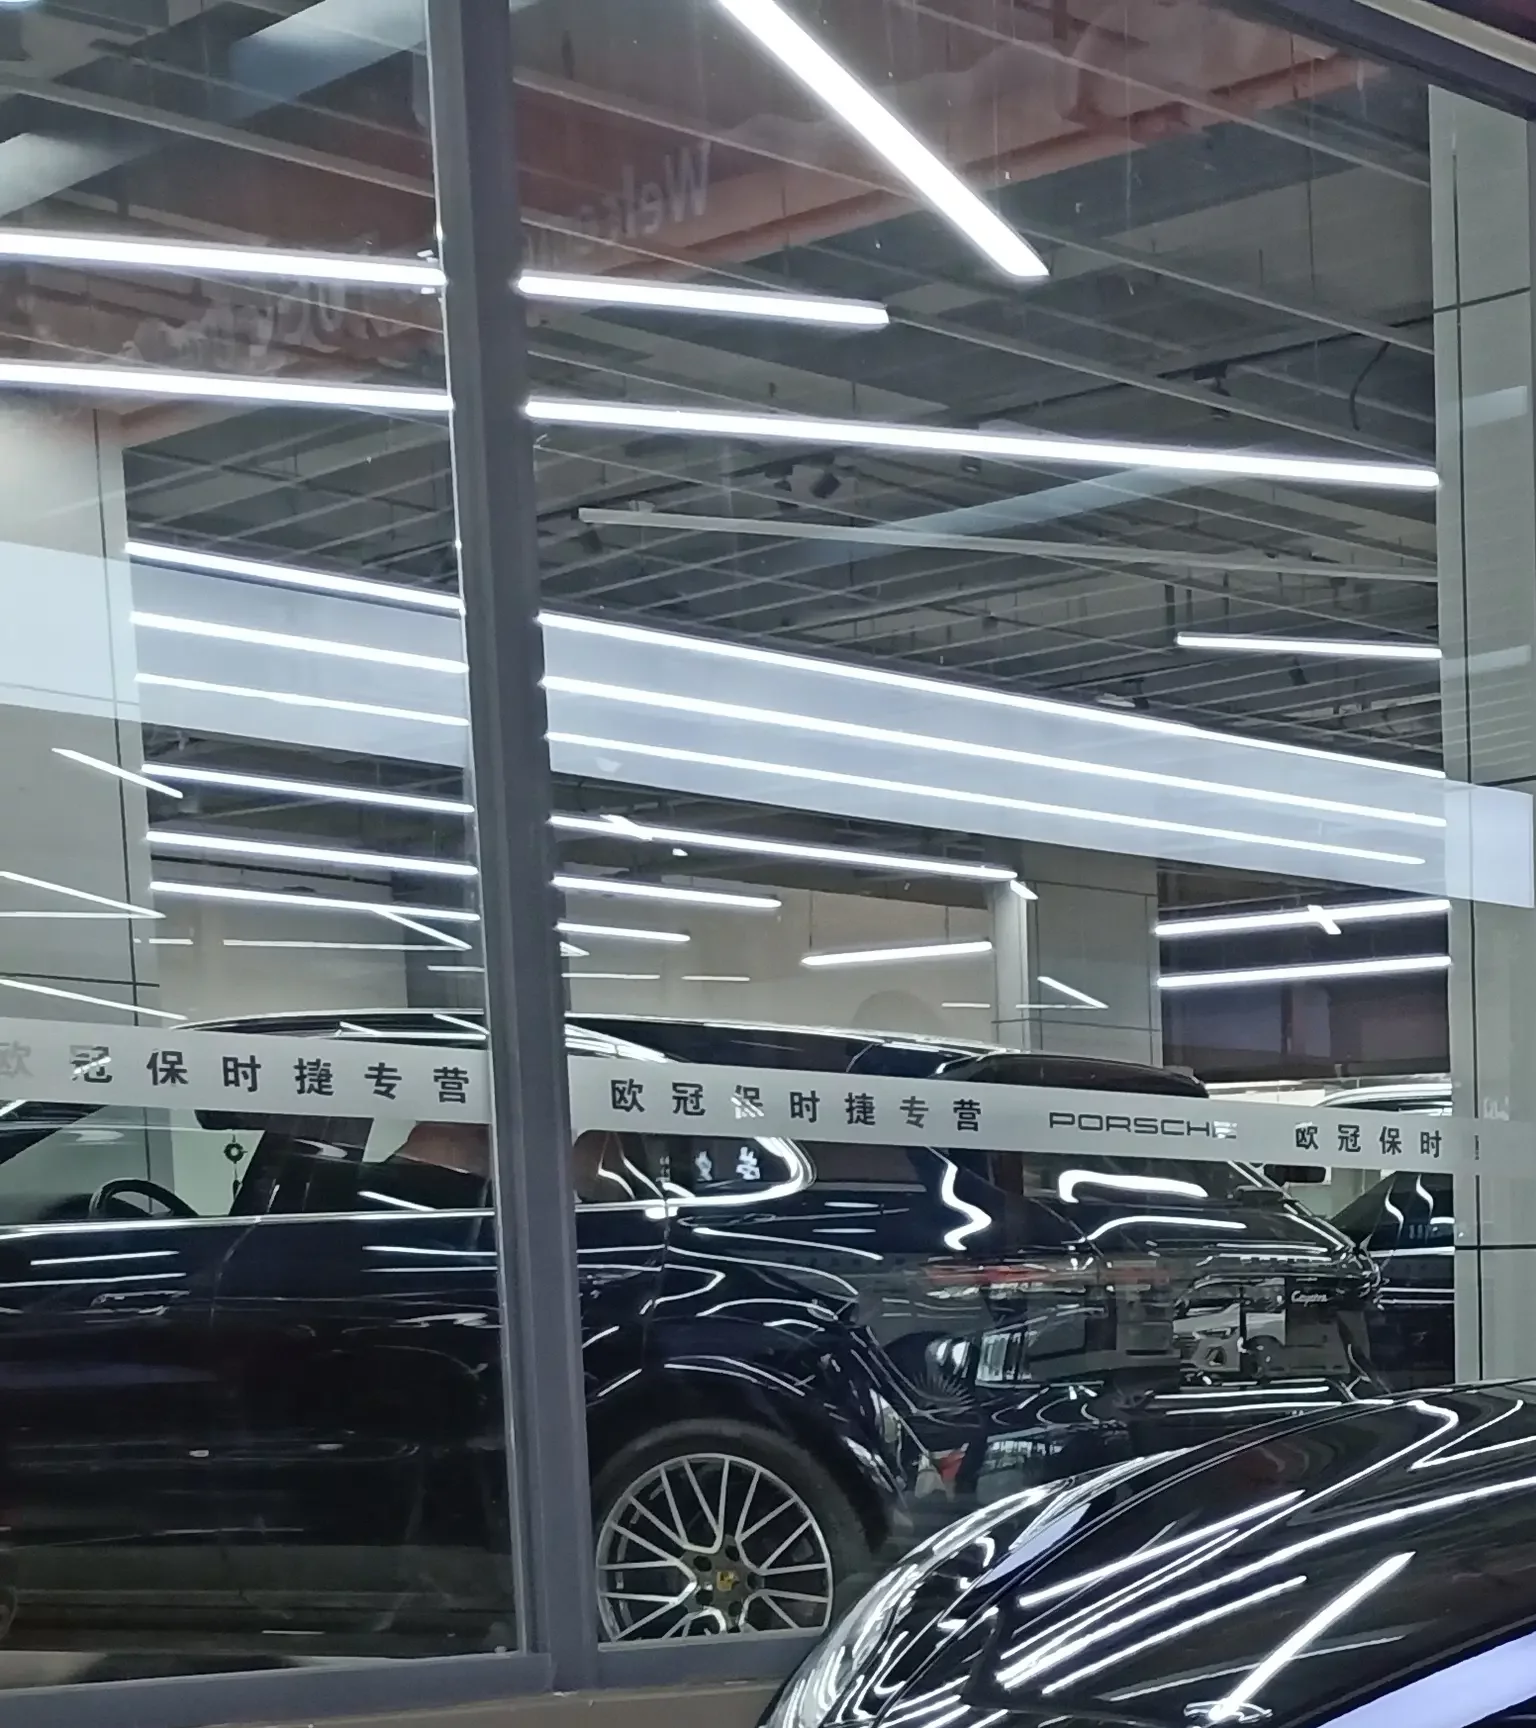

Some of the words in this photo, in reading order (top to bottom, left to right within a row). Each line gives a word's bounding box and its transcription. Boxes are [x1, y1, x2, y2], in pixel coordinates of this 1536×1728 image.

[609, 1078, 983, 1133] 欧冠保时捷专营
[1048, 1111, 1238, 1140] PORSCHE
